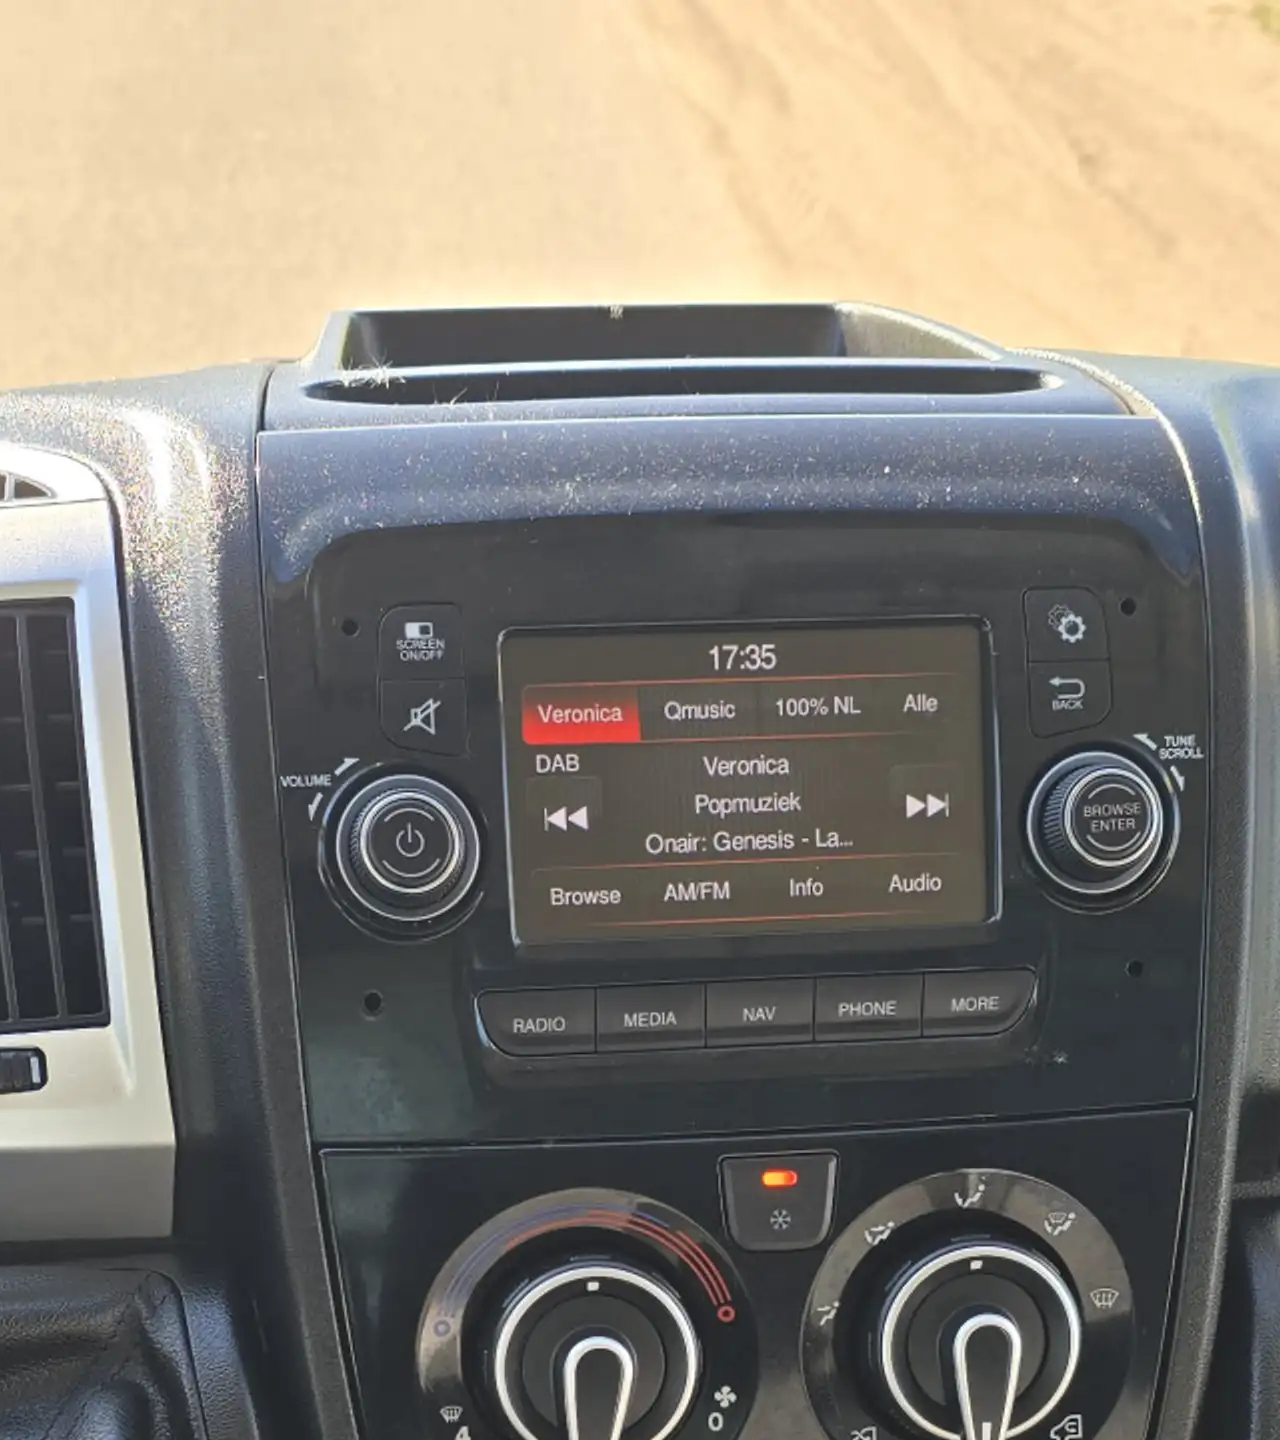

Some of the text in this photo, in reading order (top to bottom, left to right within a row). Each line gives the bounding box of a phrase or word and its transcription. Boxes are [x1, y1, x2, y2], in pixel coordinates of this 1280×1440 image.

[397, 639, 445, 650] SCREEN
[400, 650, 444, 661] ON/OFF
[709, 643, 777, 671] 17:35
[664, 701, 736, 722] Qmusic
[775, 696, 861, 717] 100% NL
[903, 693, 938, 713] Alle
[1052, 699, 1084, 711] BACK
[538, 704, 623, 725] Veronica
[1164, 735, 1195, 747] TUNE
[1160, 746, 1204, 759] SCROLL
[536, 753, 580, 774] DAB
[703, 755, 790, 777] Veronica
[280, 774, 332, 788] VOLUME
[695, 792, 802, 817] Popmuziek
[1084, 802, 1141, 818] BROWSE
[1091, 818, 1137, 832] ENTER
[646, 834, 708, 855] Onair:
[713, 832, 795, 853] Genesis
[664, 881, 731, 902] AM/FM
[789, 878, 824, 898] Info
[889, 874, 942, 895] Audio
[551, 886, 622, 907] Browse
[838, 1000, 897, 1018] PHONE
[951, 995, 1000, 1013] MORE
[624, 1010, 677, 1029] MEDIA
[743, 1006, 777, 1023] NAV
[513, 1016, 566, 1033] RADIO
